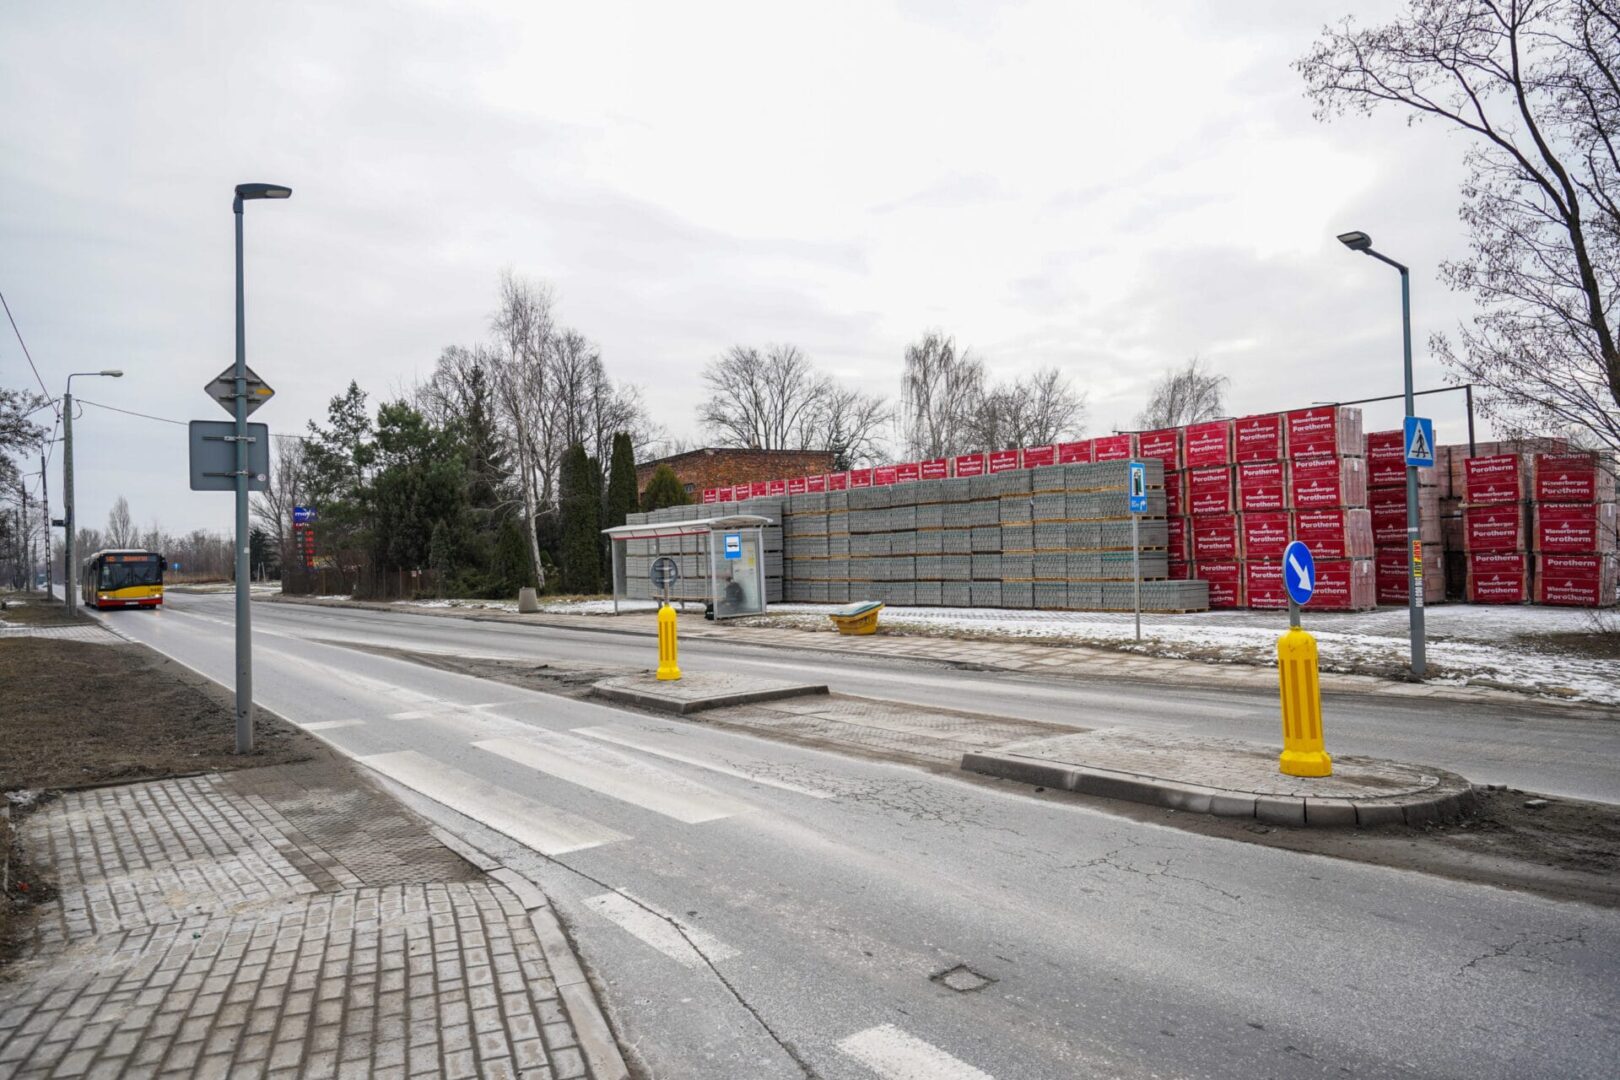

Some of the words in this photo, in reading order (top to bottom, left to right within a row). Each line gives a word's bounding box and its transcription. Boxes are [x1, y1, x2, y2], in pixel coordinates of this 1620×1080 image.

[1292, 416, 1330, 424] Wienerberger
[1240, 426, 1274, 434] Wienerberger
[1293, 423, 1331, 432] Porotherm
[1240, 433, 1275, 441] Porotherm
[1190, 445, 1223, 453] Porotherm
[1296, 460, 1336, 468] Porotherm
[1470, 458, 1512, 466] Wienerberger
[1244, 468, 1279, 476] Porotherm
[1471, 465, 1513, 474] Porotherm
[1548, 559, 1596, 567] Porotherm
[1547, 586, 1594, 594] Wienerberger
